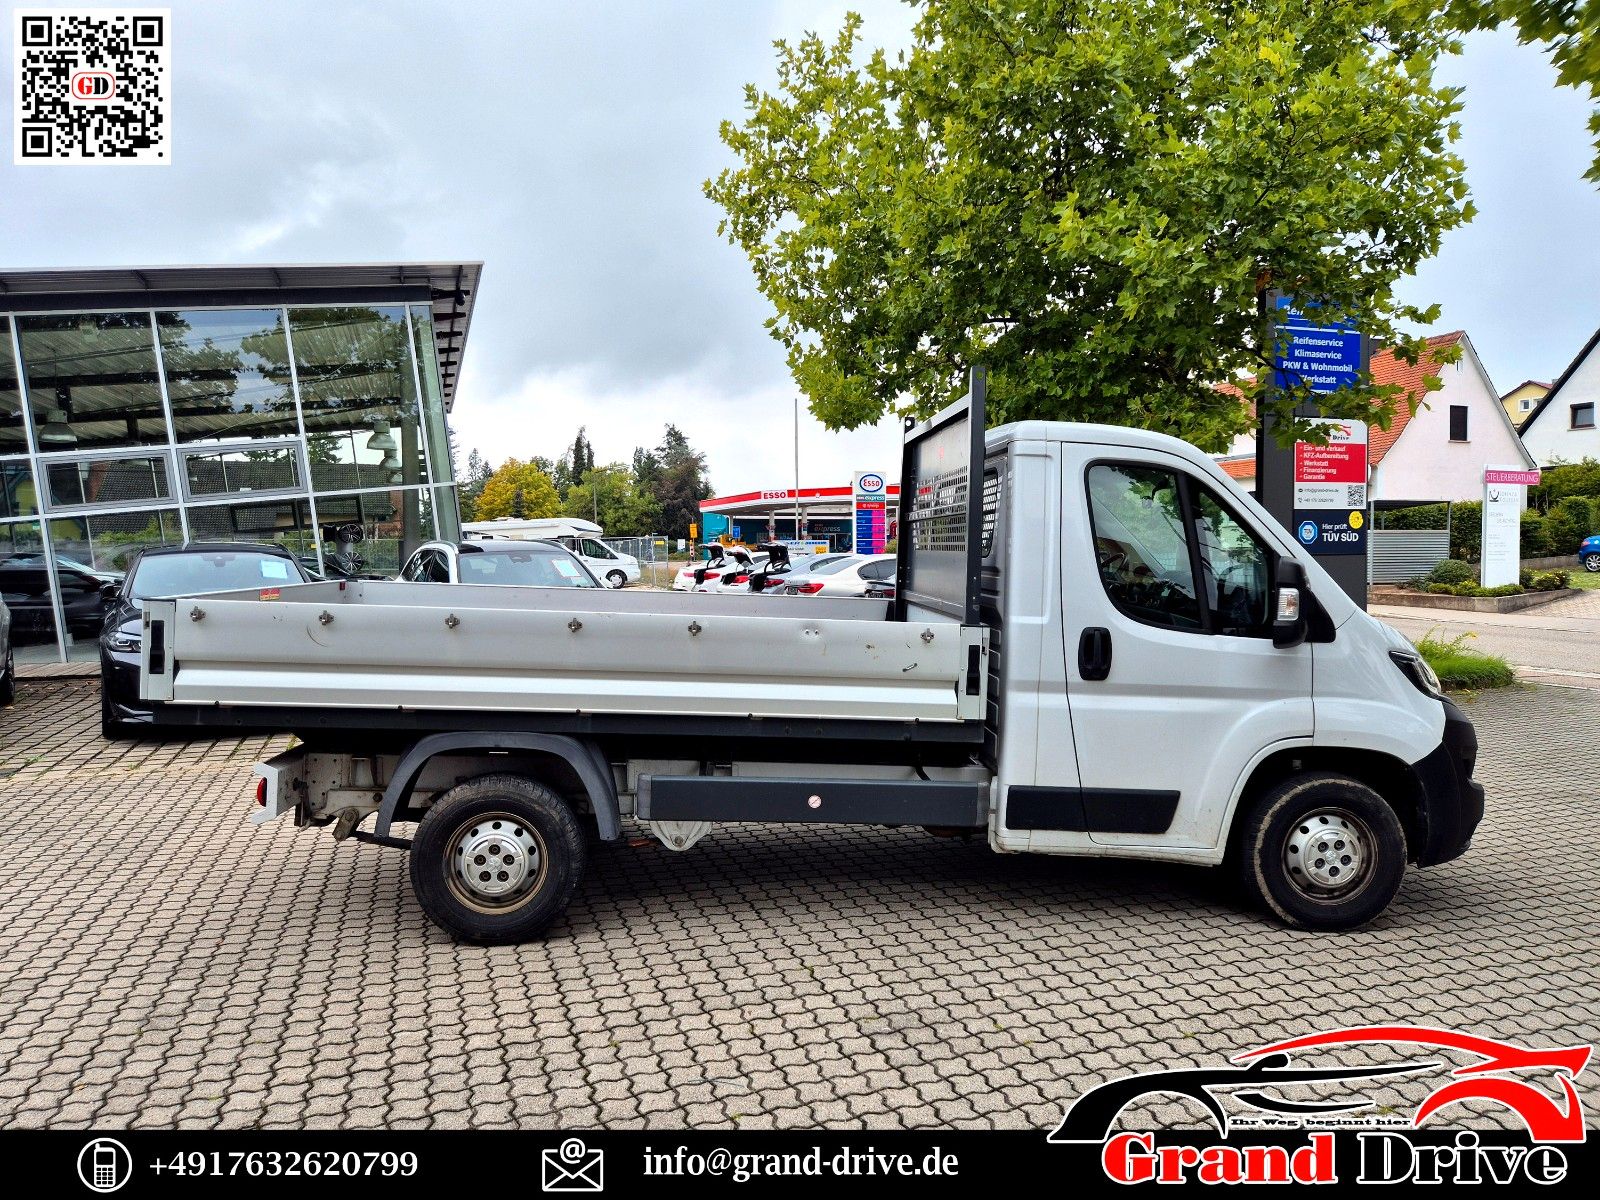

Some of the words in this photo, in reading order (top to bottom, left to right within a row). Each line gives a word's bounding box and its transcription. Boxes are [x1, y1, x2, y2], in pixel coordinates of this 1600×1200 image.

[1293, 336, 1344, 347] Reifenservice
[1294, 349, 1342, 360] Klimaservice
[1282, 360, 1302, 370] PKW
[1303, 361, 1309, 370] &
[1310, 362, 1353, 373] Wohnmobil
[1303, 467, 1337, 475] Finanzierung
[1486, 472, 1539, 483] STEUERBERATUNG
[763, 491, 787, 500] ESSO
[1334, 523, 1348, 531] prüft
[1322, 531, 1339, 541] TÜV
[1341, 531, 1359, 541] SÜD
